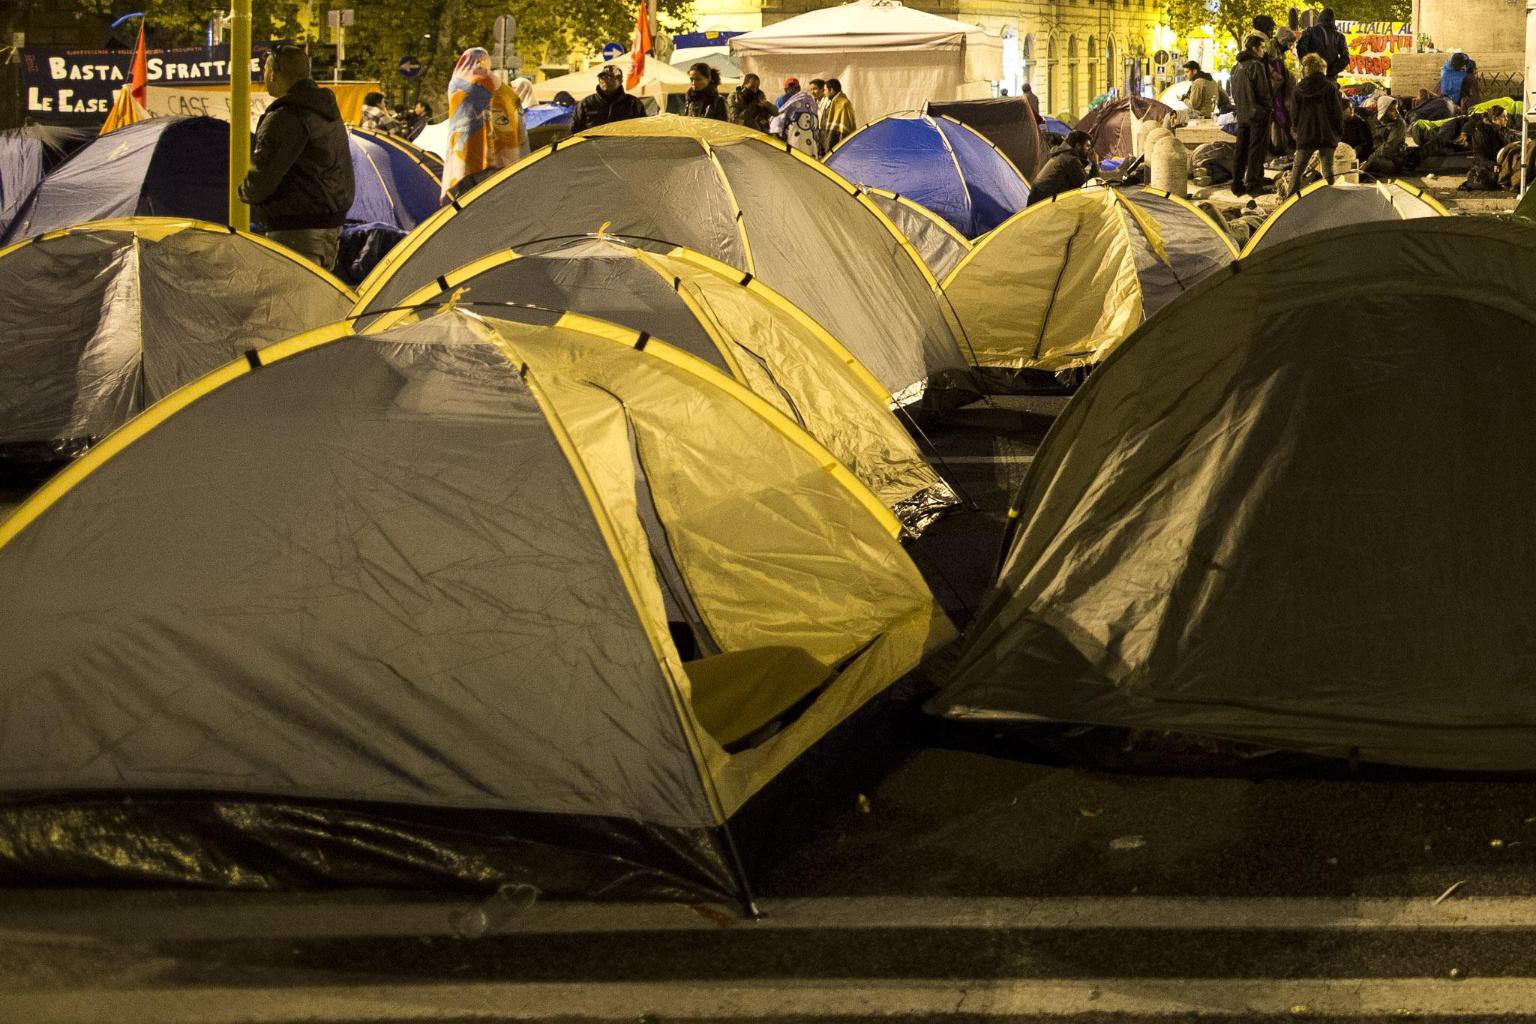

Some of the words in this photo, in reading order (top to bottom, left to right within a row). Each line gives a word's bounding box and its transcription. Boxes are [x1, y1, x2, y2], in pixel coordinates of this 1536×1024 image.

[48, 57, 124, 80] BASTA
[28, 87, 53, 111] LE
[58, 89, 108, 113] CASE
